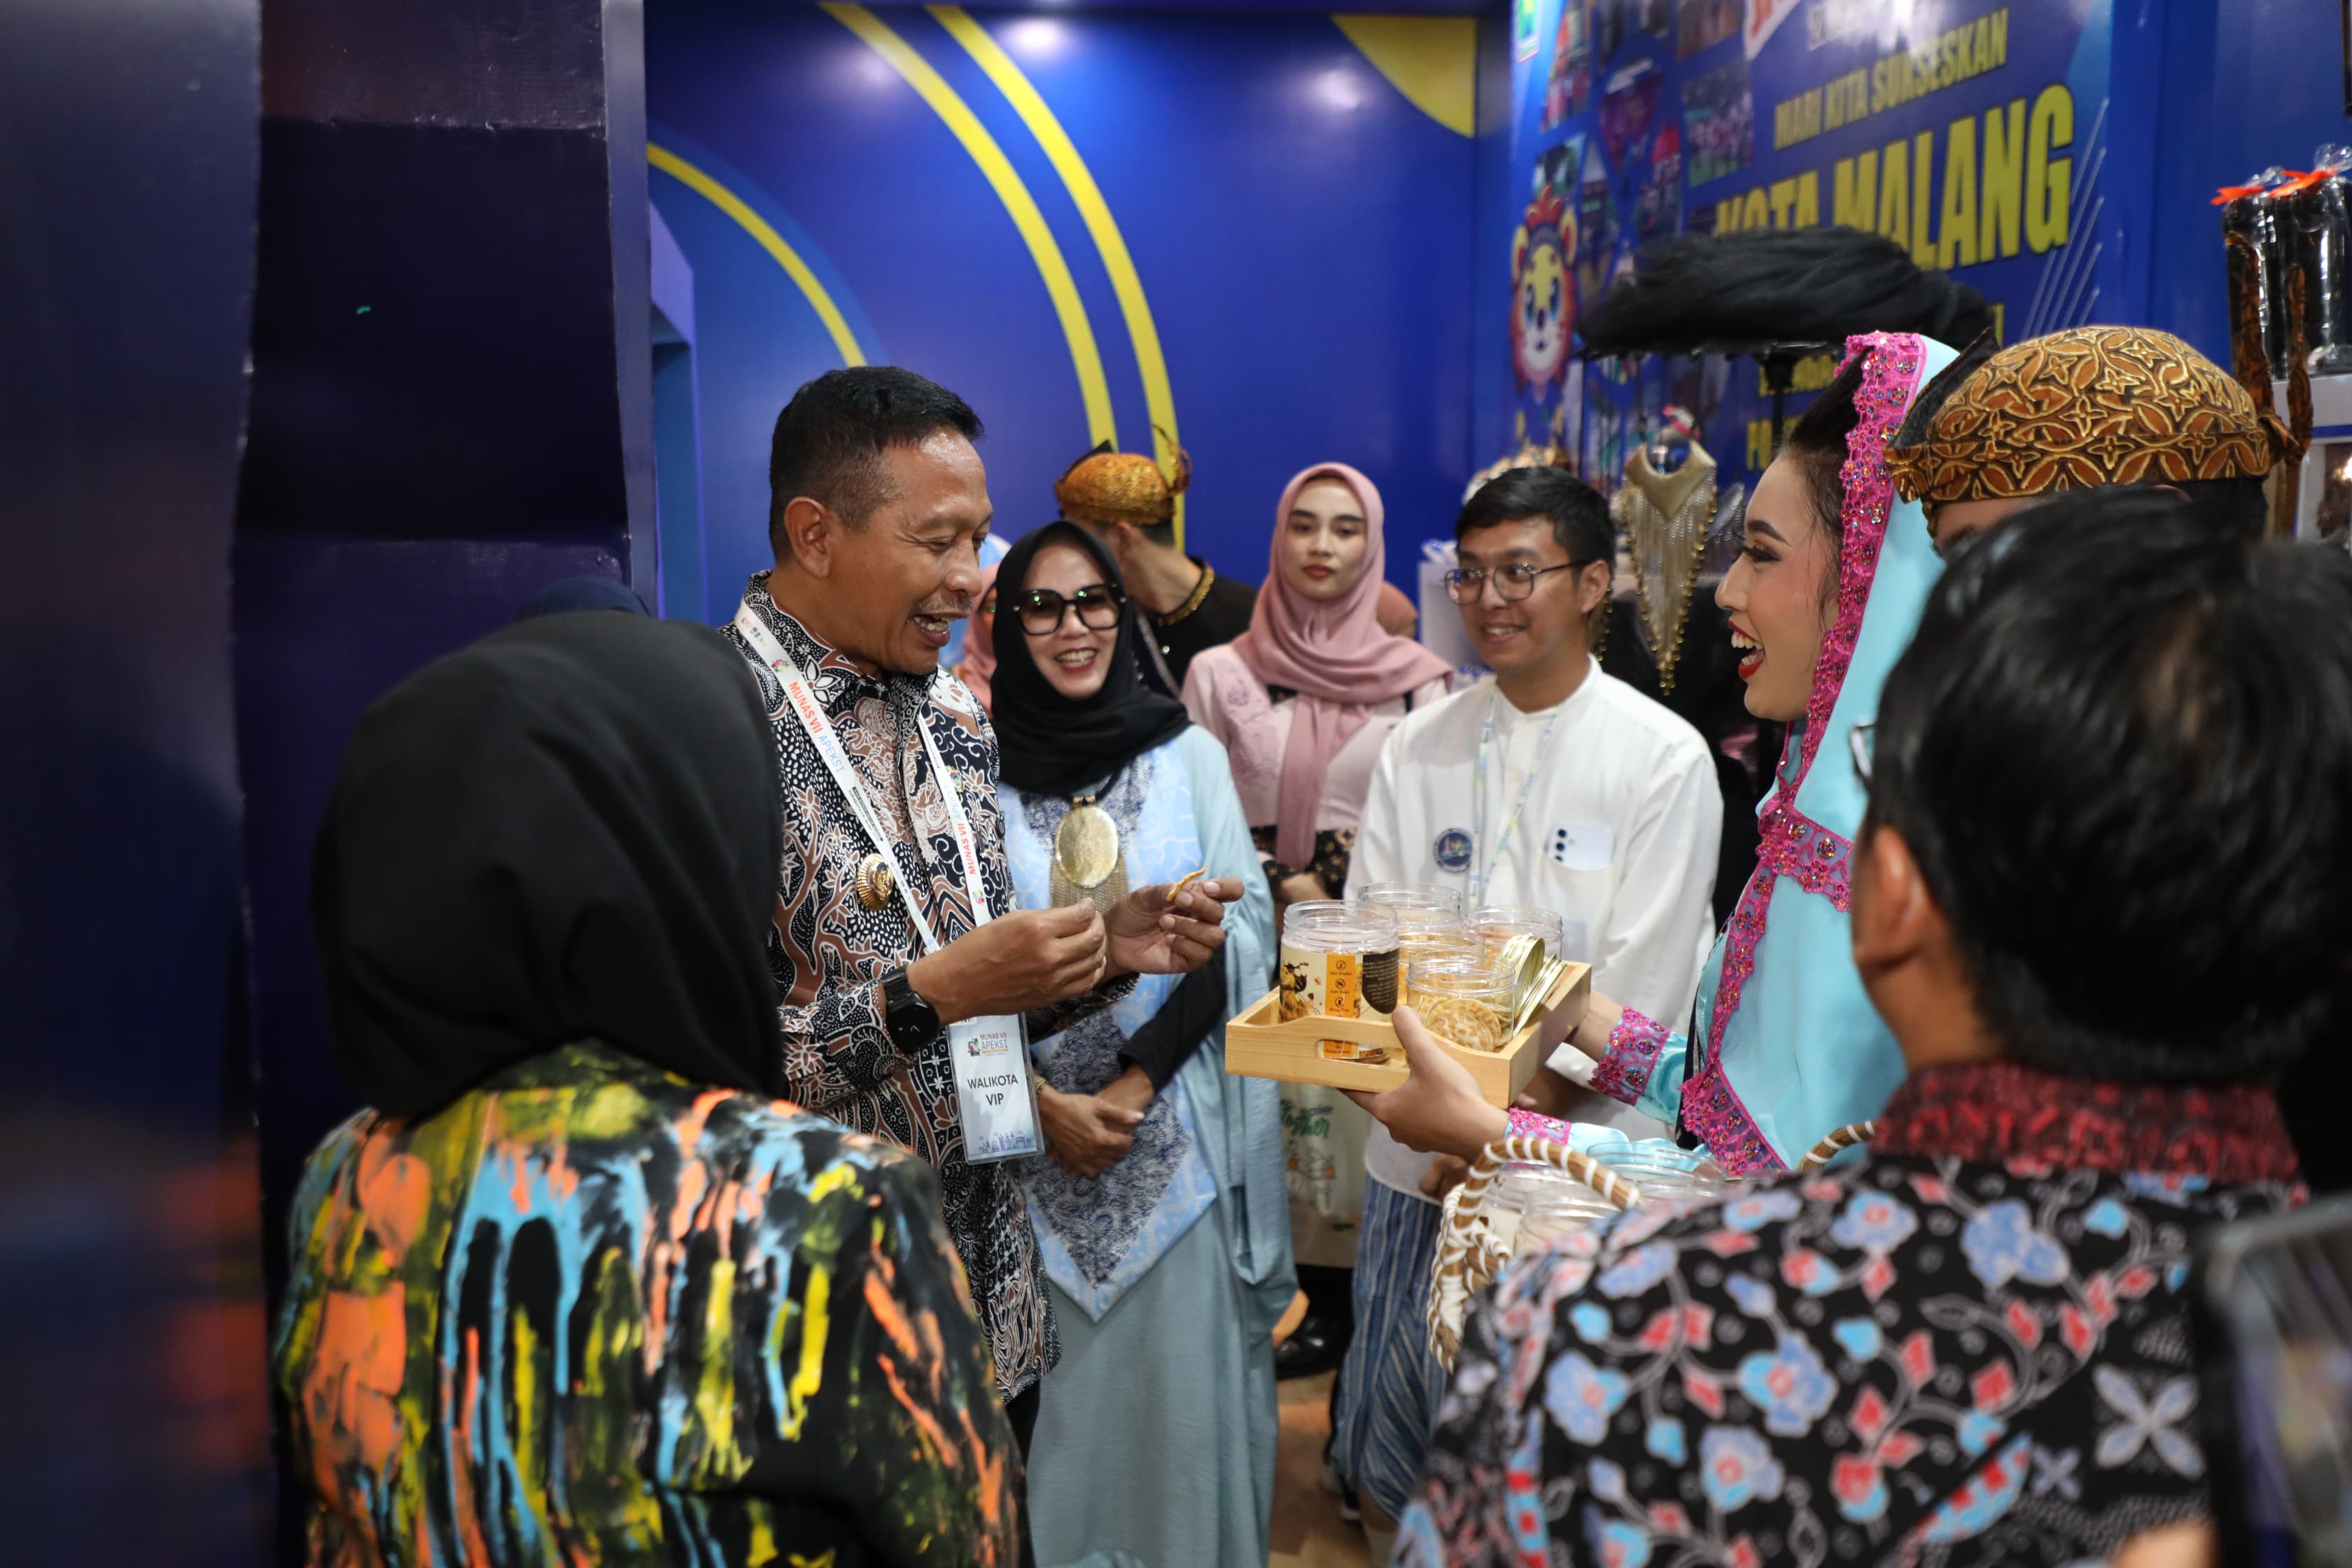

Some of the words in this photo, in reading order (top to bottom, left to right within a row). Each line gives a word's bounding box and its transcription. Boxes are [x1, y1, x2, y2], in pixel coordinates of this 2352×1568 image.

[1824, 68, 1868, 132] KITA
[1833, 83, 2074, 272] MALANG
[788, 682, 815, 720] MUNAS
[809, 718, 823, 734] VII
[818, 735, 846, 774] APEKSI
[944, 785, 962, 820] APEKSI
[957, 823, 967, 837] VII
[961, 839, 976, 875] MUNAS
[981, 1040, 1008, 1050] APEKSI
[967, 1074, 1018, 1089] WALIKOTA
[986, 1093, 1004, 1106] VIP
